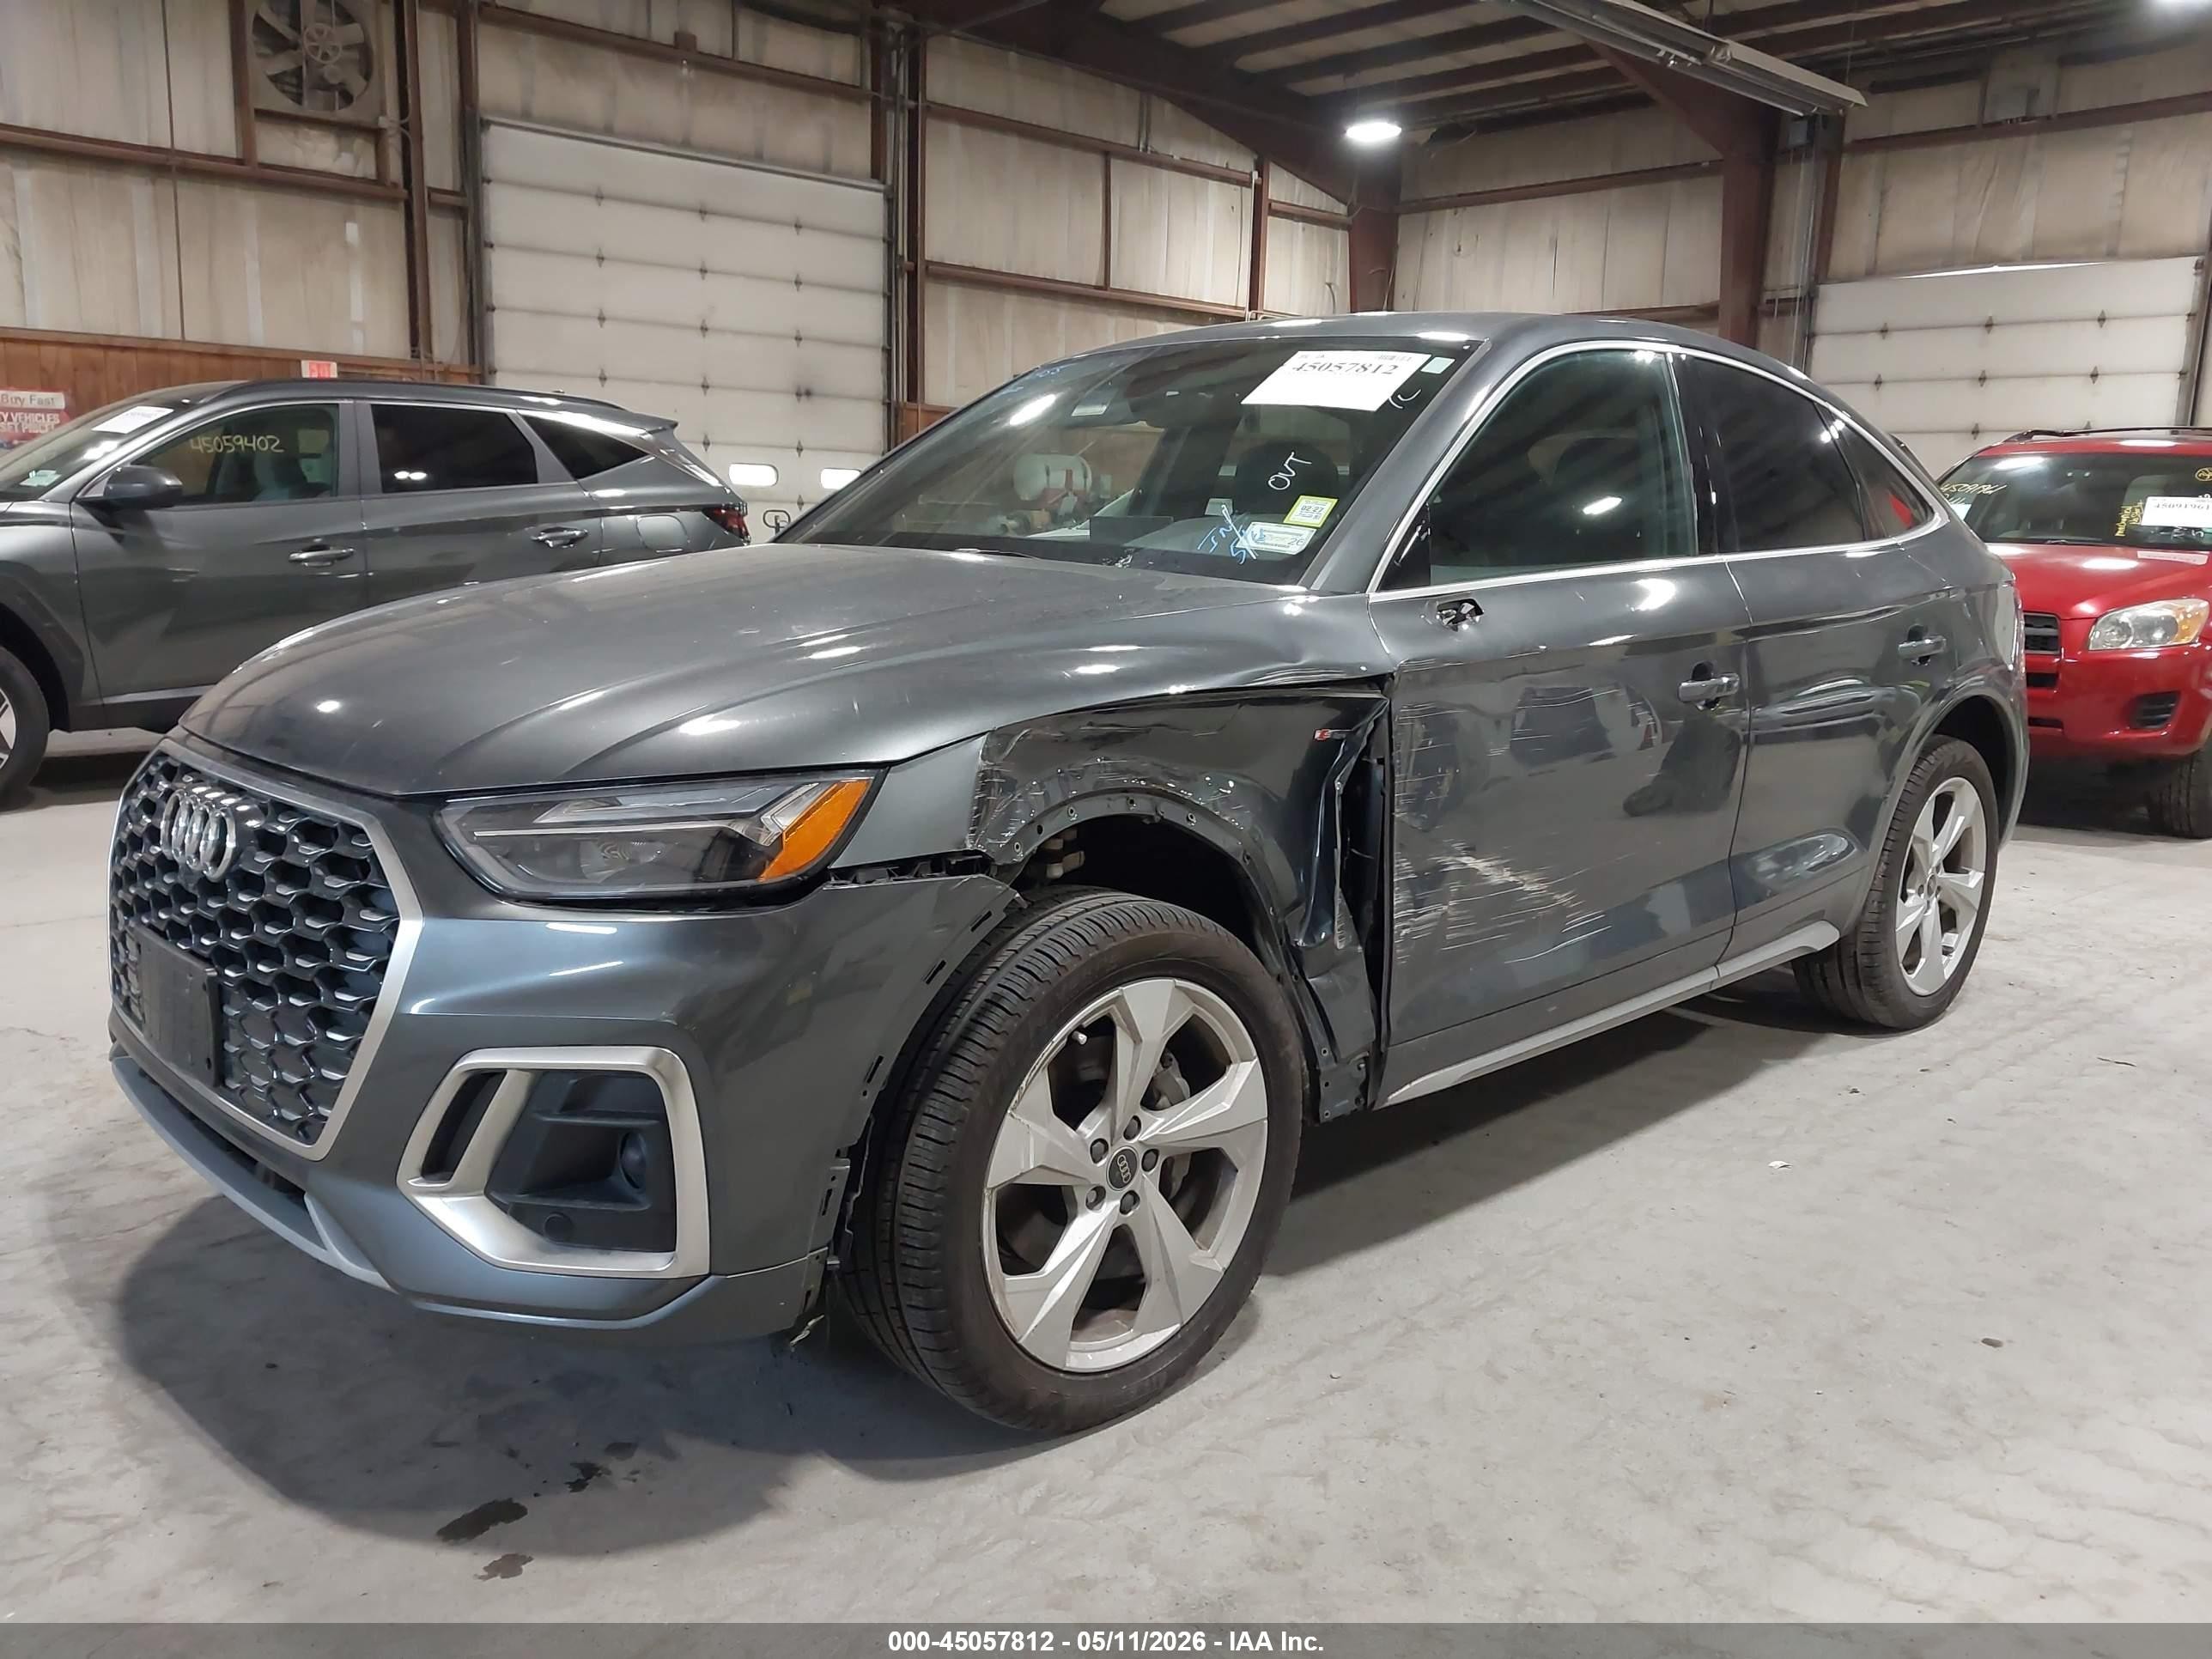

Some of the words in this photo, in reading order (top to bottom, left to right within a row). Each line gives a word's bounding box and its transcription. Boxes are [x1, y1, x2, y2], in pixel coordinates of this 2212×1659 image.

[1292, 362, 1399, 374] 45057812
[0, 393, 25, 407] Buy
[29, 394, 56, 405] Fast
[10, 412, 60, 424] VEHICLES
[190, 435, 284, 453] 45059402
